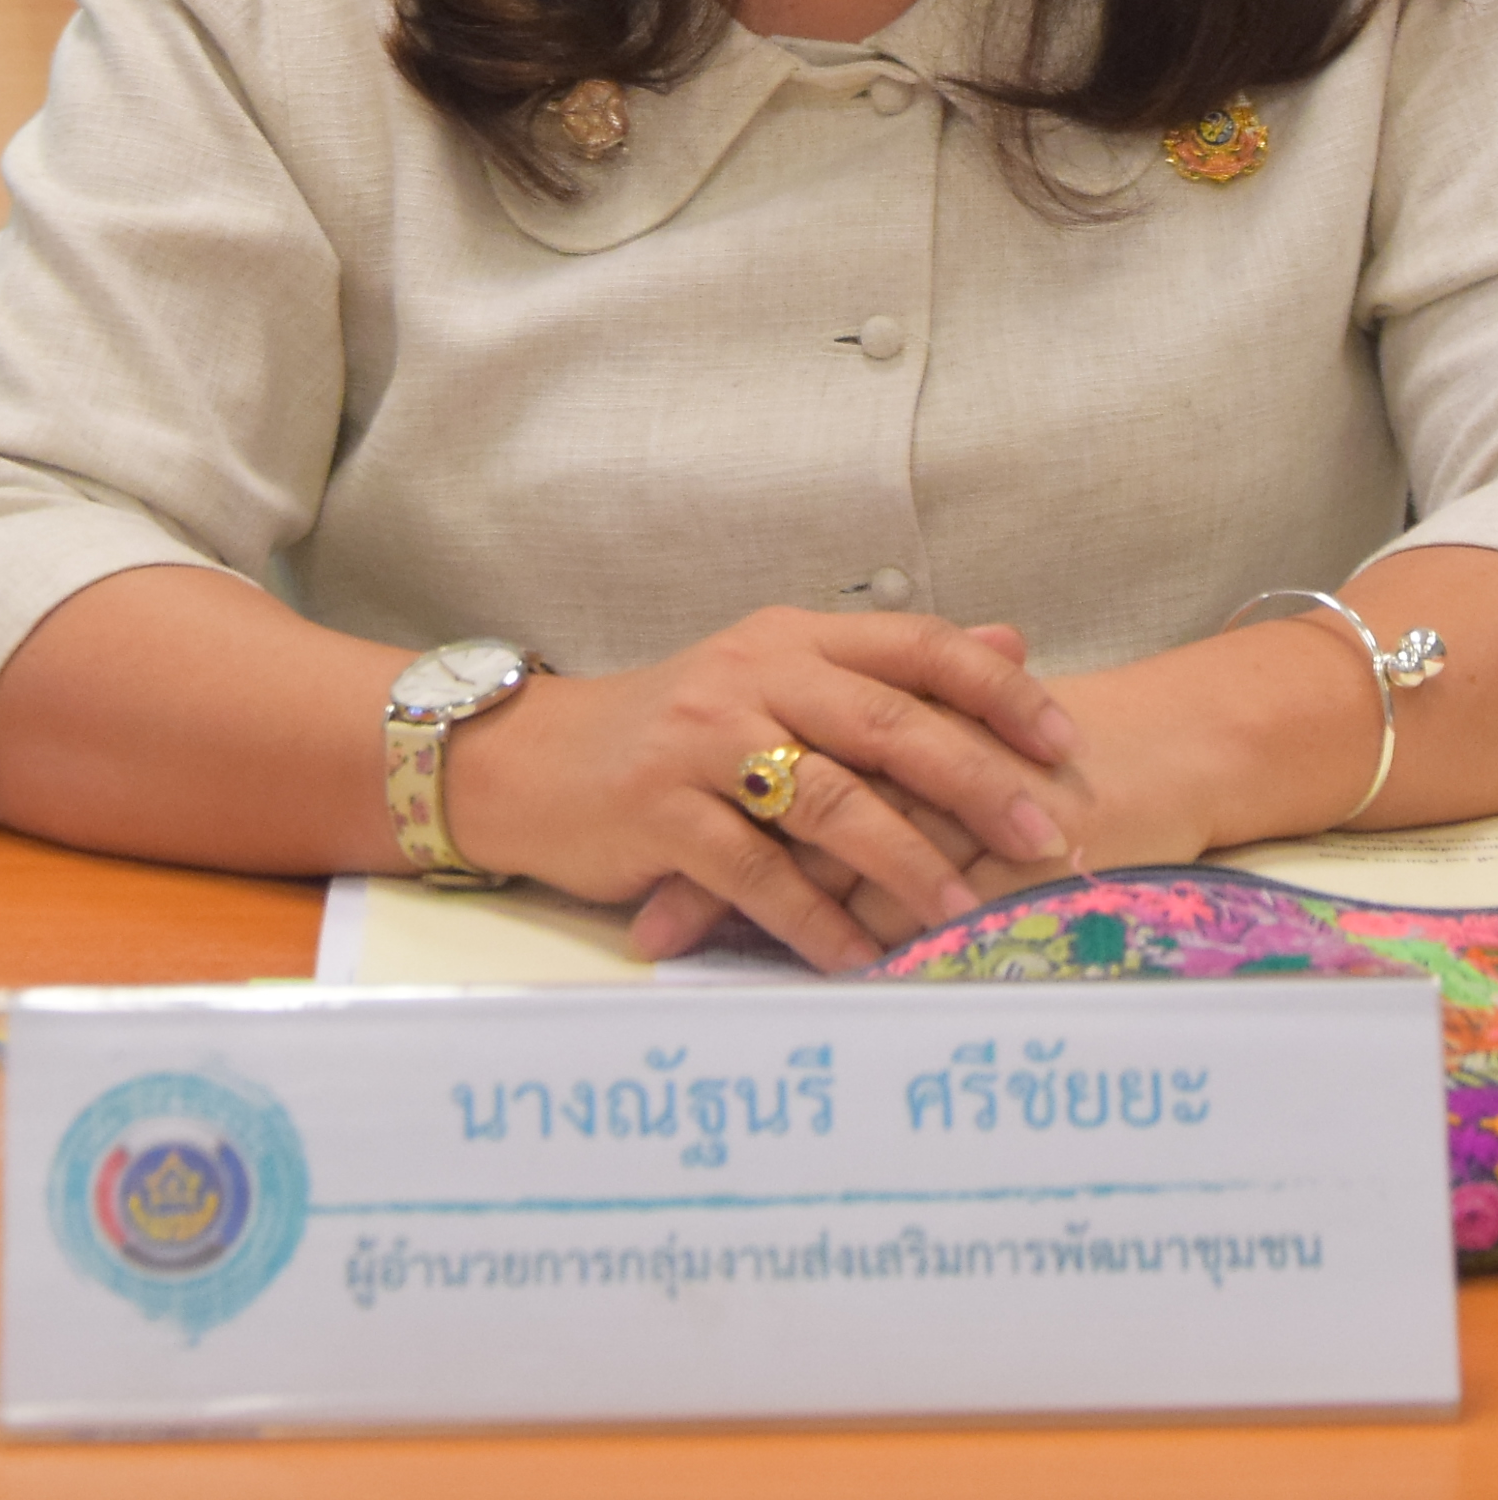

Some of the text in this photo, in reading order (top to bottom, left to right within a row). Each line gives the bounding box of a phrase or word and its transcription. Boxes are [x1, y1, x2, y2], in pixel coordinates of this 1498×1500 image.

[452, 1038, 1209, 1169] นางณัฐนรี ศรีชัยยะ
[345, 1219, 1324, 1308] ผู้อำนวยการกลุ่มงานส่งเสริมการพัฒนาชุมชน
